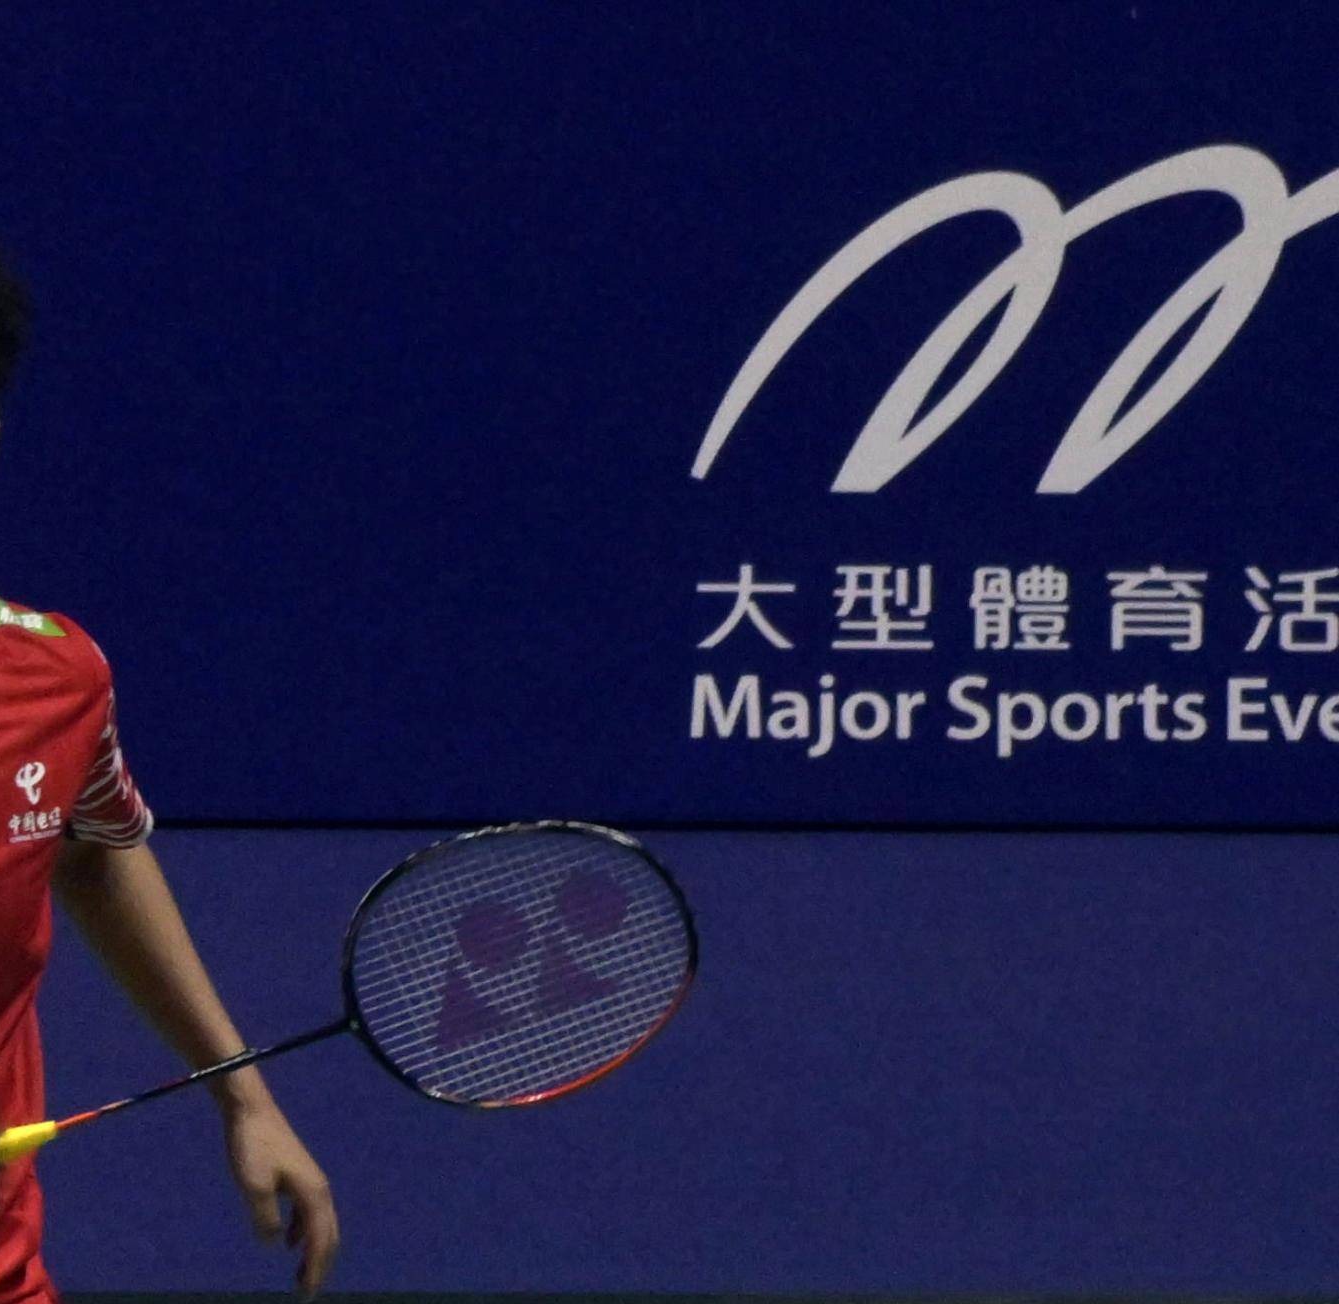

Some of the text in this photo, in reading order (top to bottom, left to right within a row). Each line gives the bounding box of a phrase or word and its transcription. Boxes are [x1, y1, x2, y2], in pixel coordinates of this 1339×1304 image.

[696, 563, 1339, 653] 大型體育活
[689, 673, 927, 758] Major
[946, 674, 1208, 758] Sports
